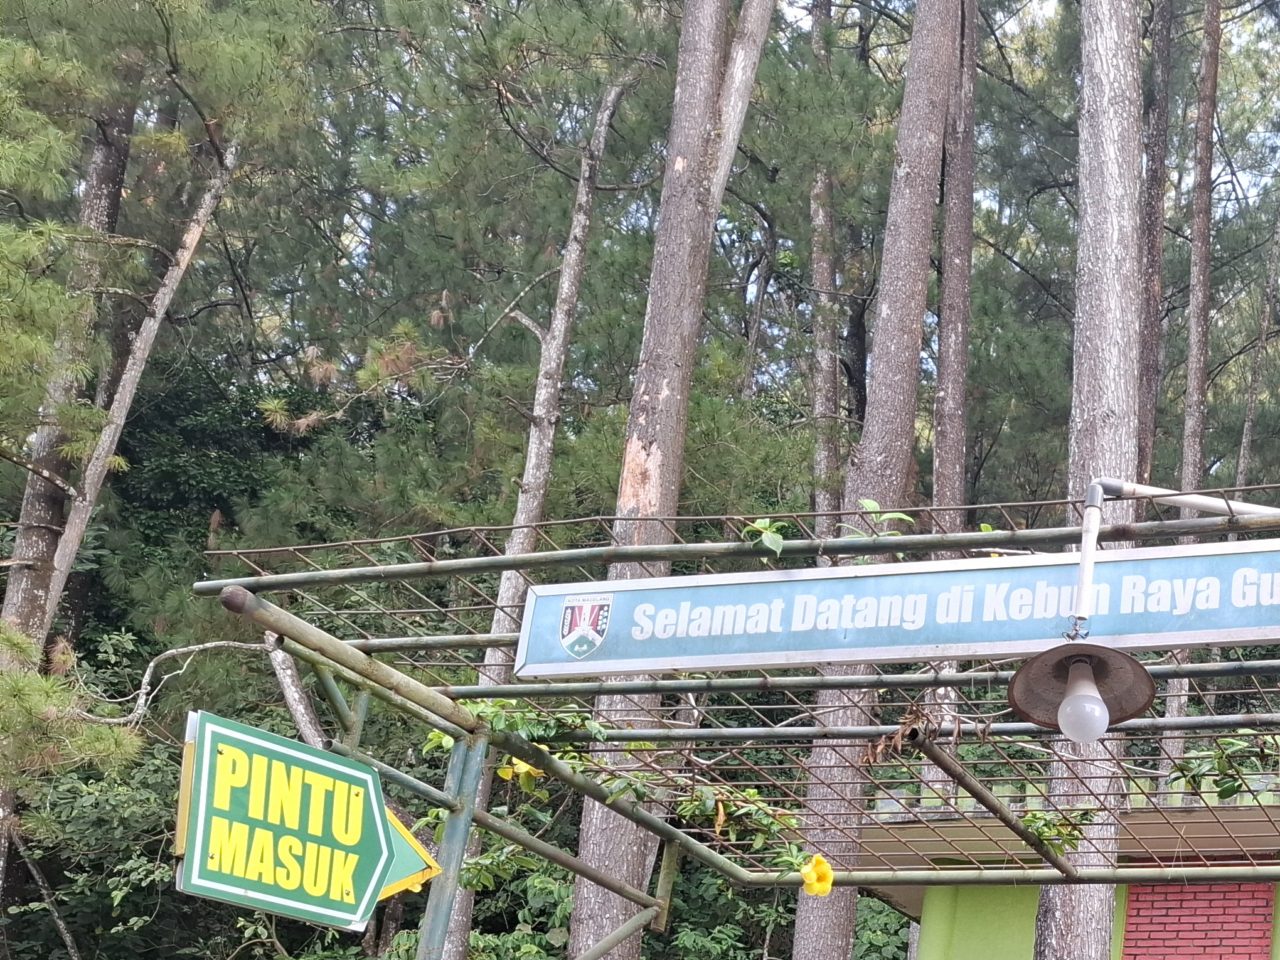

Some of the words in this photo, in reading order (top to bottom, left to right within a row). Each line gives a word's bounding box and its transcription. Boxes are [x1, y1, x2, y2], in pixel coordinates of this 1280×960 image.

[631, 598, 785, 641] Selamat
[791, 592, 928, 631] Datang
[935, 585, 975, 625] di
[982, 580, 1111, 623] Kebun
[1120, 575, 1220, 616] Raya
[213, 743, 365, 846] PINTU
[206, 815, 360, 905] MASUK
